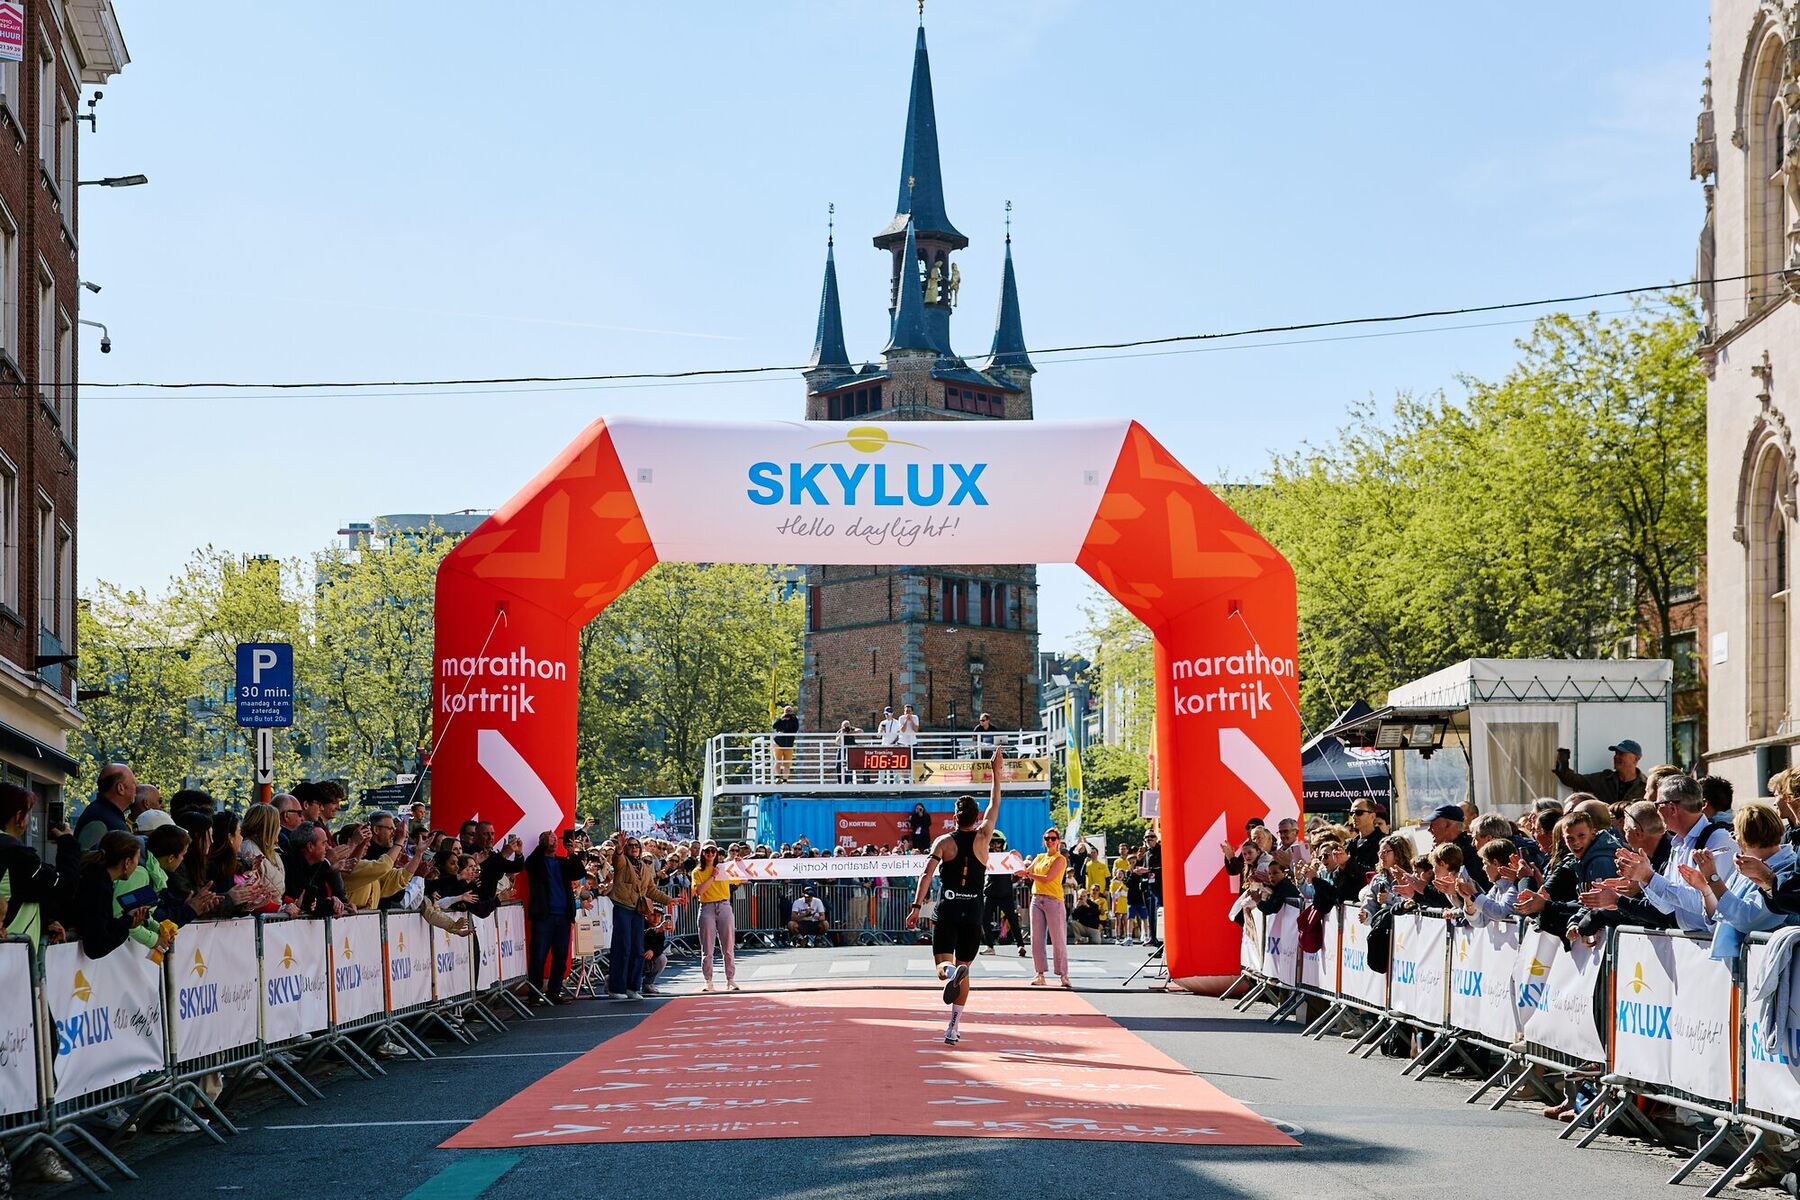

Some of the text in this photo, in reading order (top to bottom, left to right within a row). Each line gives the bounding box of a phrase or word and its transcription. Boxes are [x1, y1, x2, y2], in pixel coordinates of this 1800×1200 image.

[747, 461, 989, 507] SKYLUX
[776, 514, 960, 547] Hello daylight!
[252, 649, 278, 684] P
[442, 646, 566, 681] marathon
[1172, 643, 1294, 680] marathon
[240, 700, 270, 708] maandag
[241, 686, 290, 698] 30 min.
[442, 682, 535, 721] kortrijk
[1174, 680, 1272, 719] kortrijk
[251, 707, 280, 715] zaterdag
[863, 755, 908, 769] 1:06:30
[940, 762, 975, 771] RECOVERY
[1363, 789, 1391, 797] WWW.S
[179, 983, 219, 1020] SKYLUX
[1617, 1000, 1672, 1040] KYLUX
[549, 1096, 813, 1110] SKYLUX
[932, 1119, 1223, 1135] SKYLUX
